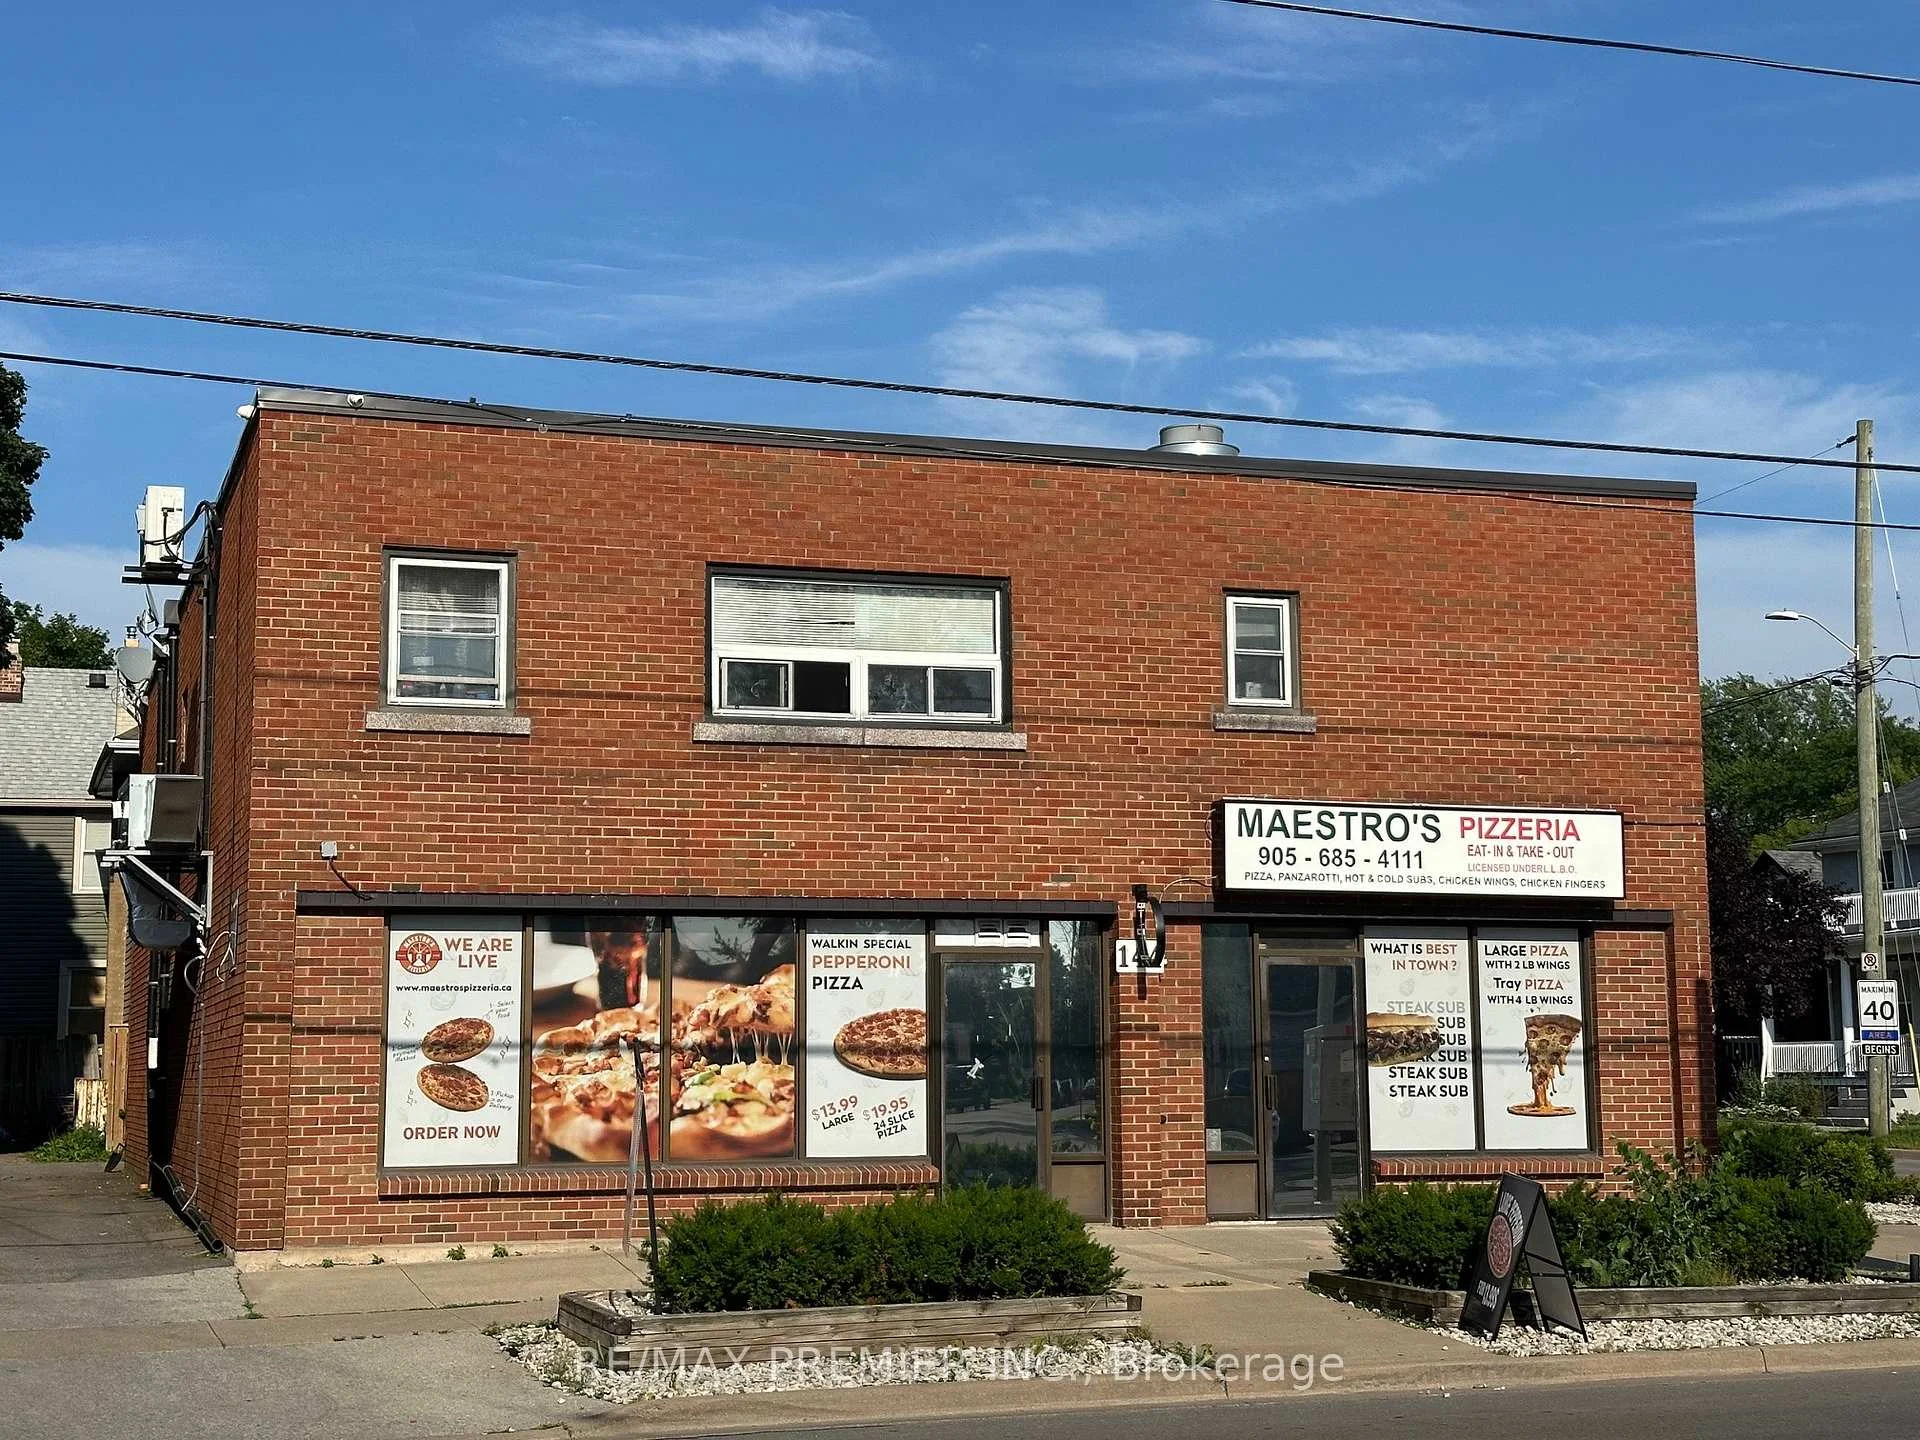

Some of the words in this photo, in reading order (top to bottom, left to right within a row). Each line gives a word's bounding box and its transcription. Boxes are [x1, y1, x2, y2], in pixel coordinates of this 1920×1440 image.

[1237, 808, 1441, 843] MAESTRO'S
[1460, 816, 1581, 841] PIZZERIA
[1258, 846, 1297, 866] 905
[1319, 848, 1356, 867] 685
[1377, 850, 1423, 869] 4111
[1506, 845, 1514, 857] &
[1517, 845, 1544, 858] TAKE
[1552, 846, 1575, 858] OUT
[1467, 863, 1511, 873] LICENSED
[1244, 871, 1276, 882] PIZZA,
[1278, 872, 1343, 884] PANZAROTTI,
[1345, 873, 1365, 883] HOT
[1367, 874, 1374, 883] &
[1377, 874, 1404, 884] COLD
[1406, 875, 1436, 885] SUBS,
[1438, 876, 1481, 886] CHICKEN
[1483, 877, 1518, 888] WINGS,
[1520, 878, 1562, 888] CHICKEN
[1565, 879, 1606, 889] FINGERS
[444, 938, 473, 951] WE
[477, 938, 513, 951] ARE
[812, 939, 858, 949] WALKIN
[863, 939, 911, 949] SPECIAL
[1370, 943, 1409, 954] WHAT
[1411, 943, 1423, 955] IS
[1425, 944, 1458, 955] BEST
[1484, 945, 1527, 957] LARGE
[1529, 945, 1569, 957] PIZZA
[458, 954, 498, 968] LIVE
[812, 955, 911, 968] PEPPERONI
[1392, 960, 1406, 970] IN
[1485, 960, 1512, 969] WITH
[1514, 960, 1521, 969] 2
[1522, 960, 1535, 969] LB
[1536, 960, 1571, 970] WINGS
[395, 983, 512, 993] www.maestrospizzeria.ca
[812, 976, 864, 990] PIZZA
[1493, 977, 1522, 992] Tray
[1525, 979, 1564, 991] PIZZA
[1487, 995, 1514, 1005] WITH
[1515, 995, 1522, 1005] 4
[1525, 995, 1538, 1005] LB
[1539, 995, 1574, 1005] WINGS
[1386, 1001, 1434, 1013] STEAK
[1436, 1001, 1466, 1013] SUB
[1864, 1001, 1894, 1020] 40
[1437, 1017, 1466, 1029] SUB
[1439, 1033, 1467, 1046] SUB
[1438, 1050, 1468, 1062] SUB
[1865, 1045, 1896, 1054] BEGINS
[1388, 1066, 1436, 1079] STEAK
[1438, 1067, 1468, 1080] SUB
[1389, 1085, 1437, 1097] STEAK
[1439, 1085, 1469, 1097] SUB
[822, 1112, 855, 1130] LARGE
[873, 1121, 886, 1131] 24
[888, 1109, 916, 1126] SLICE
[403, 1127, 458, 1140] ORDER
[463, 1126, 501, 1139] NOW
[877, 1123, 908, 1140] PIZZA
